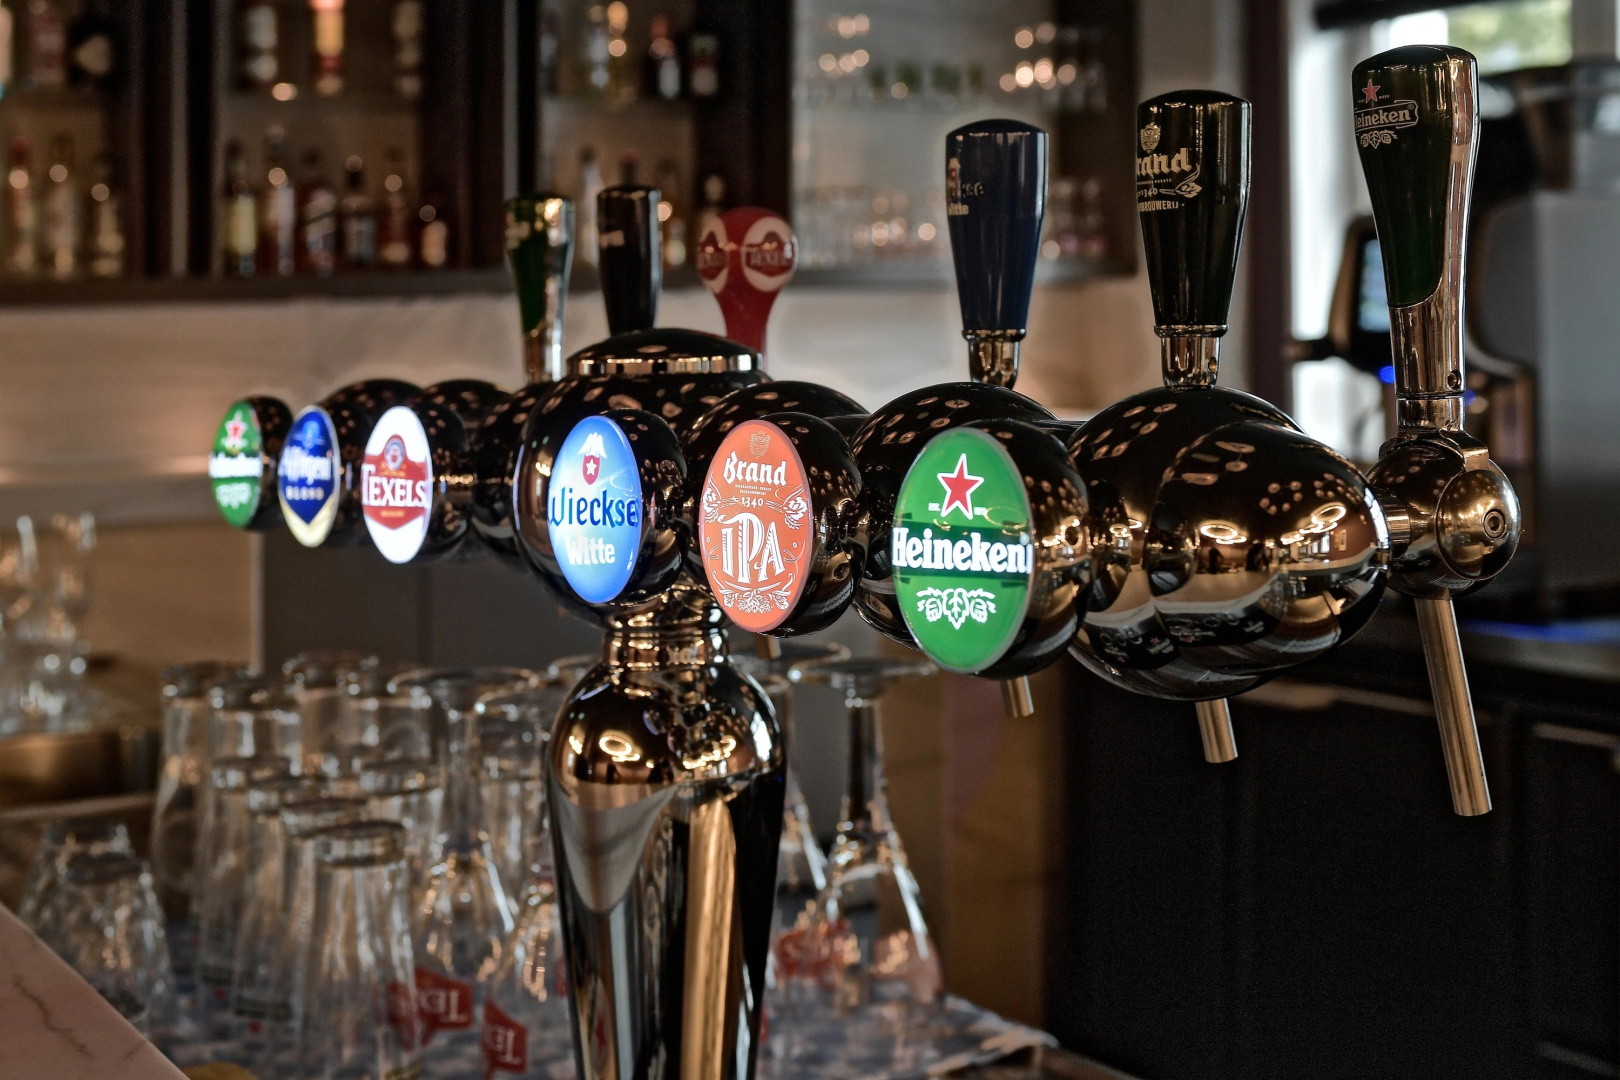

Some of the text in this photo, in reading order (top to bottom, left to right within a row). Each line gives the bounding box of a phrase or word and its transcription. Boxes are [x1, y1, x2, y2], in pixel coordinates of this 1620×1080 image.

[1137, 148, 1192, 176] rand
[361, 463, 428, 508] TEXELS
[723, 451, 787, 486] Brand
[741, 496, 764, 508] 1340
[565, 535, 615, 565] Witte
[718, 512, 786, 583] IPA
[892, 527, 1028, 574] Heineken
